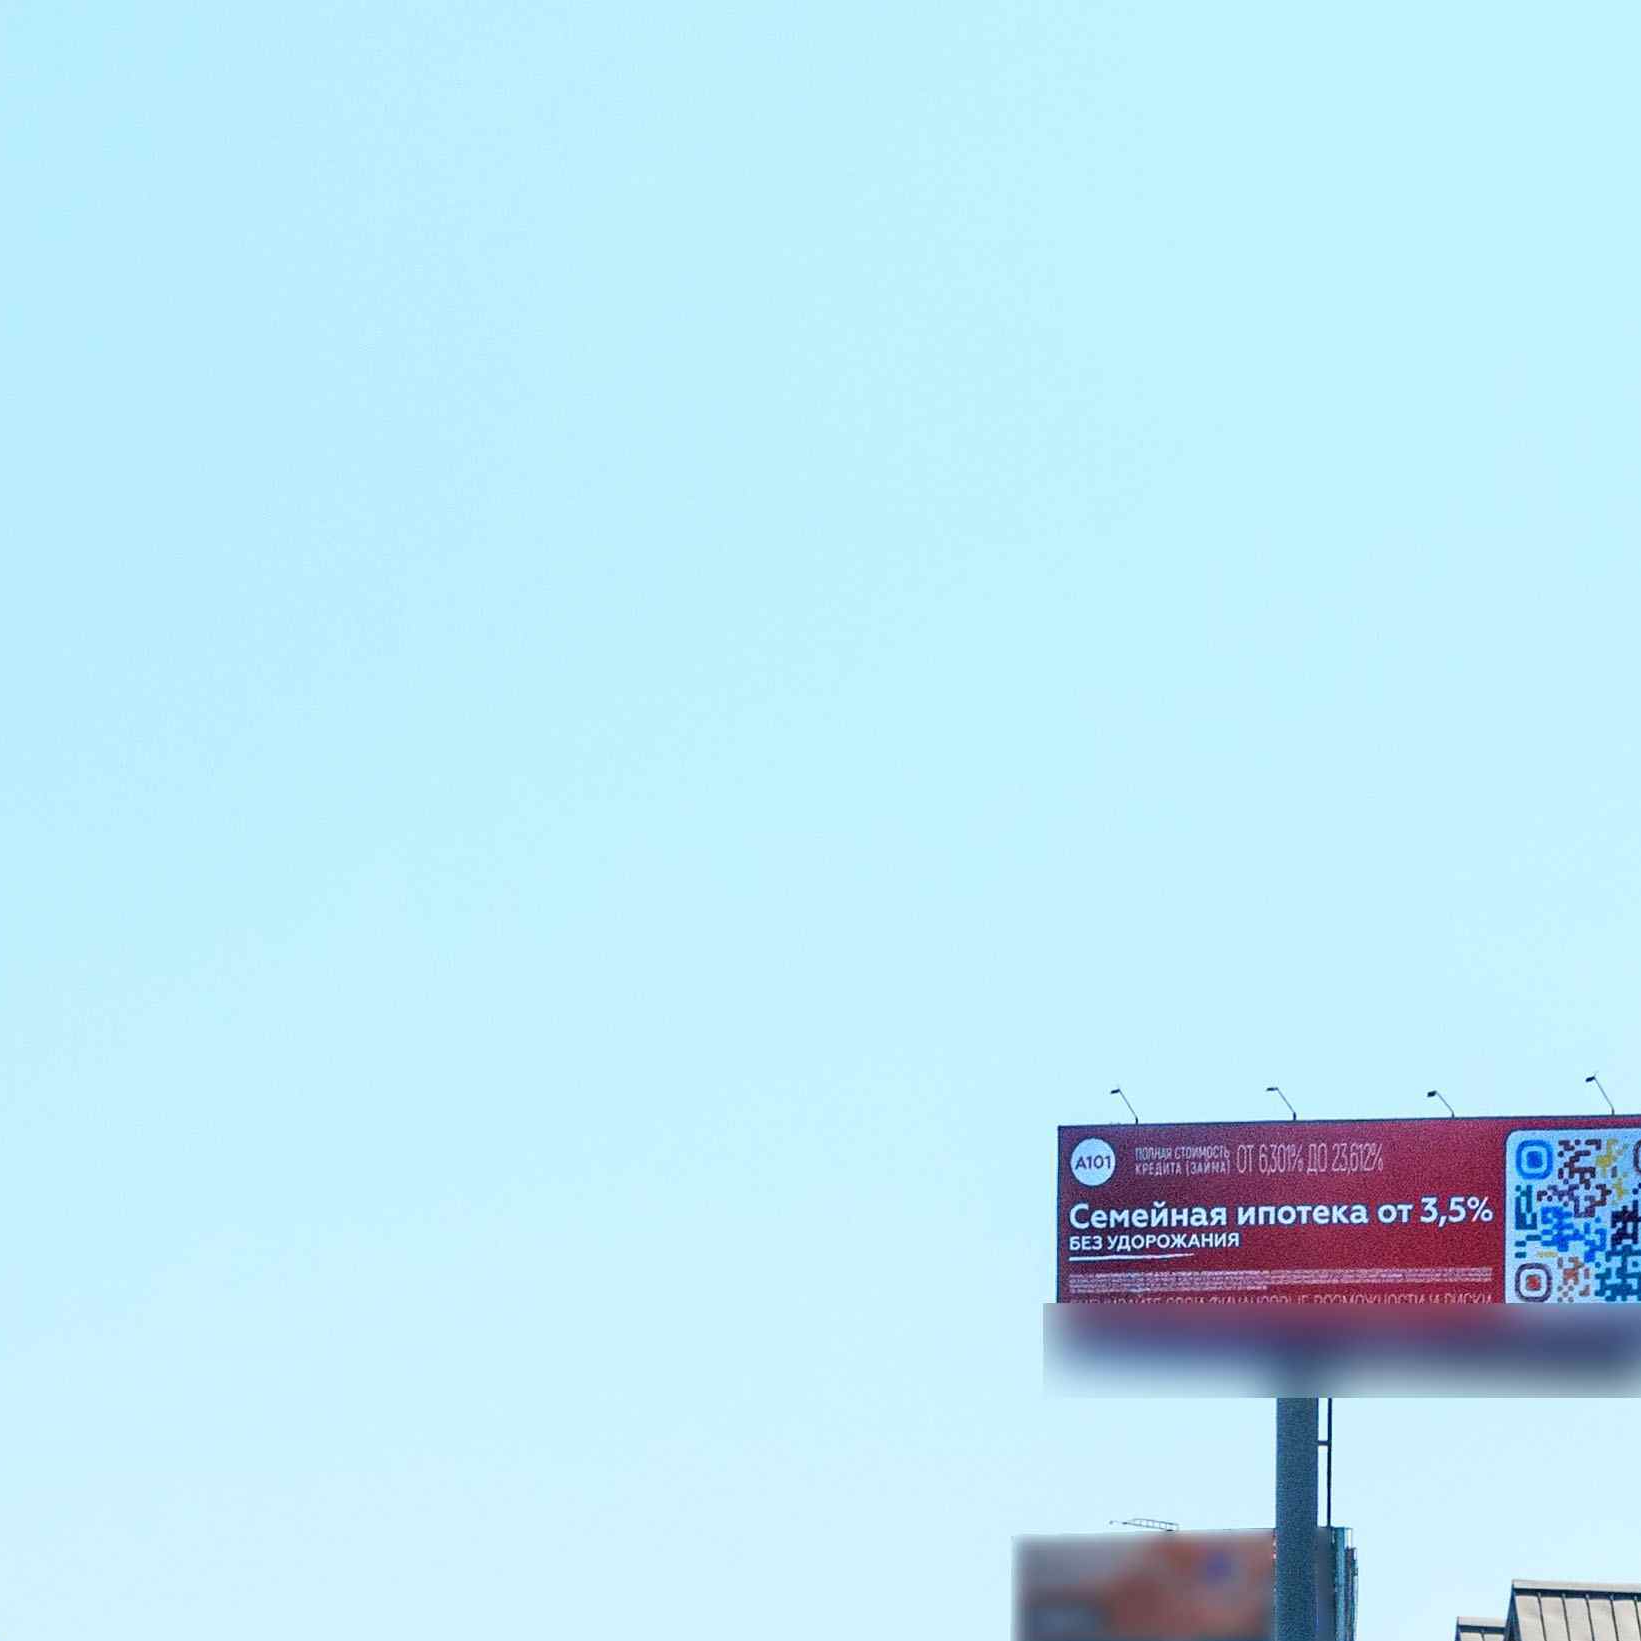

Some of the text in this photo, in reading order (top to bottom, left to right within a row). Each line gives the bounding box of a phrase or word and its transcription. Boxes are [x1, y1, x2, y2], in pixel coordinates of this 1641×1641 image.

[1174, 1144, 1231, 1160] СТОИМОСТЬ
[1237, 1144, 1254, 1174] ОТ
[1259, 1143, 1304, 1176] 6,301%
[1307, 1142, 1328, 1175] ДО
[1135, 1161, 1182, 1176] КРЕДИТА
[1069, 1196, 1494, 1230] Семейная ипотека от 3,5%
[1069, 1232, 1240, 1253] БЕЗ УДОРОЖАНИЯ
